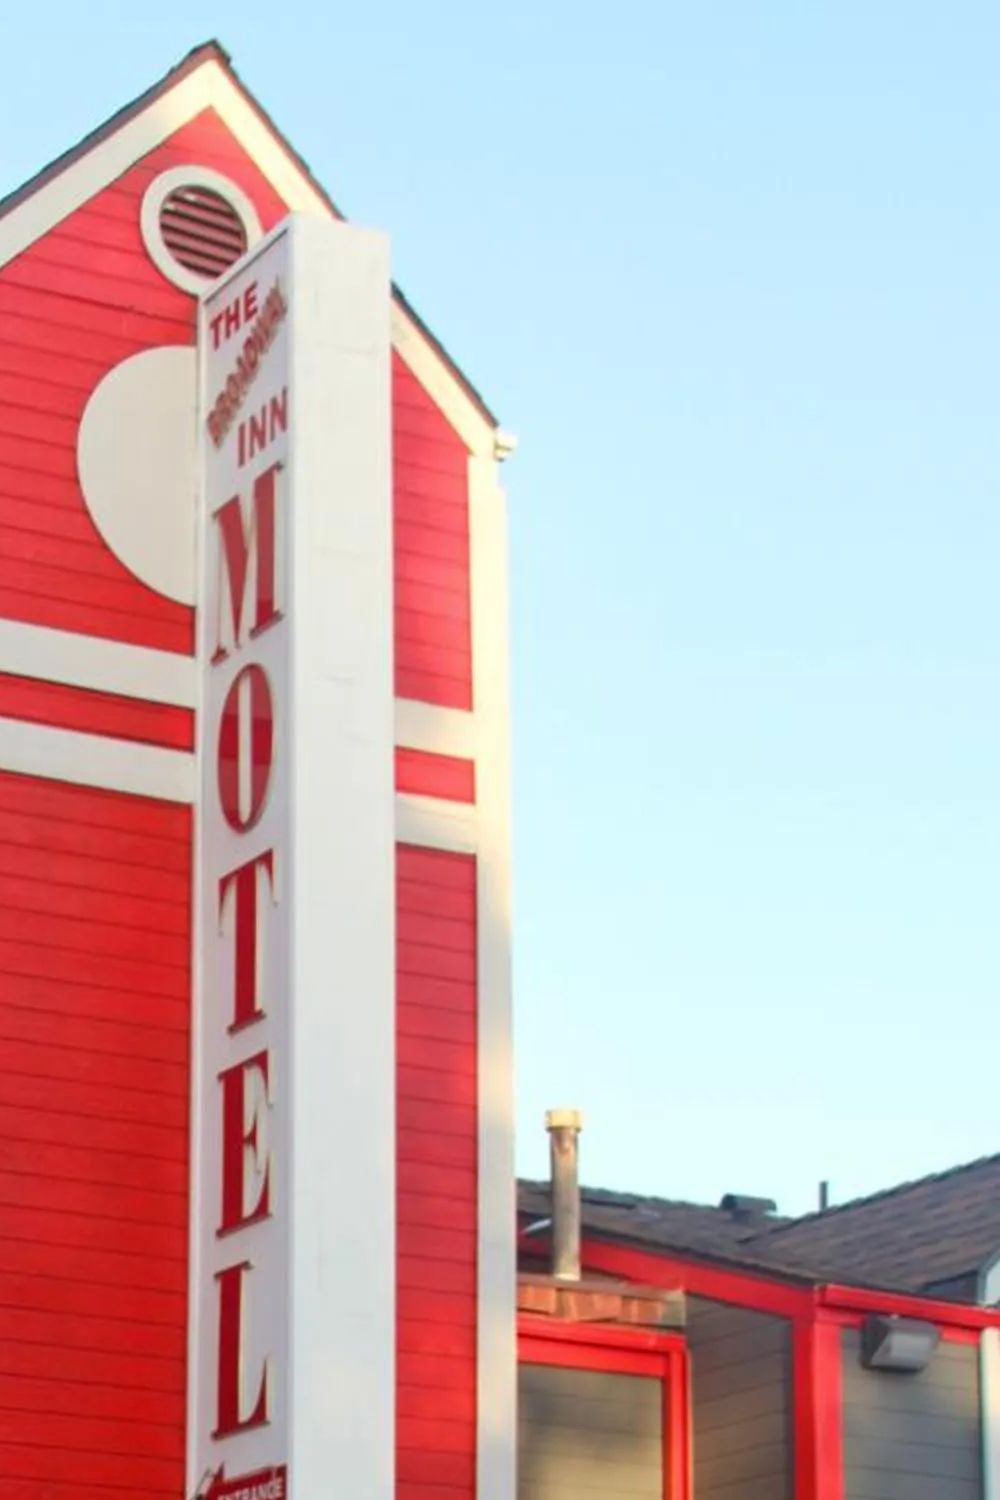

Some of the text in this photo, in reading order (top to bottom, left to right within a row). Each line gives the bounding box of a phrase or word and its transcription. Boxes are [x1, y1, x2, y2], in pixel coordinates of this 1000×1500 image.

[210, 281, 258, 351] THE
[238, 386, 288, 468] INN
[210, 461, 284, 1441] MOTEL
